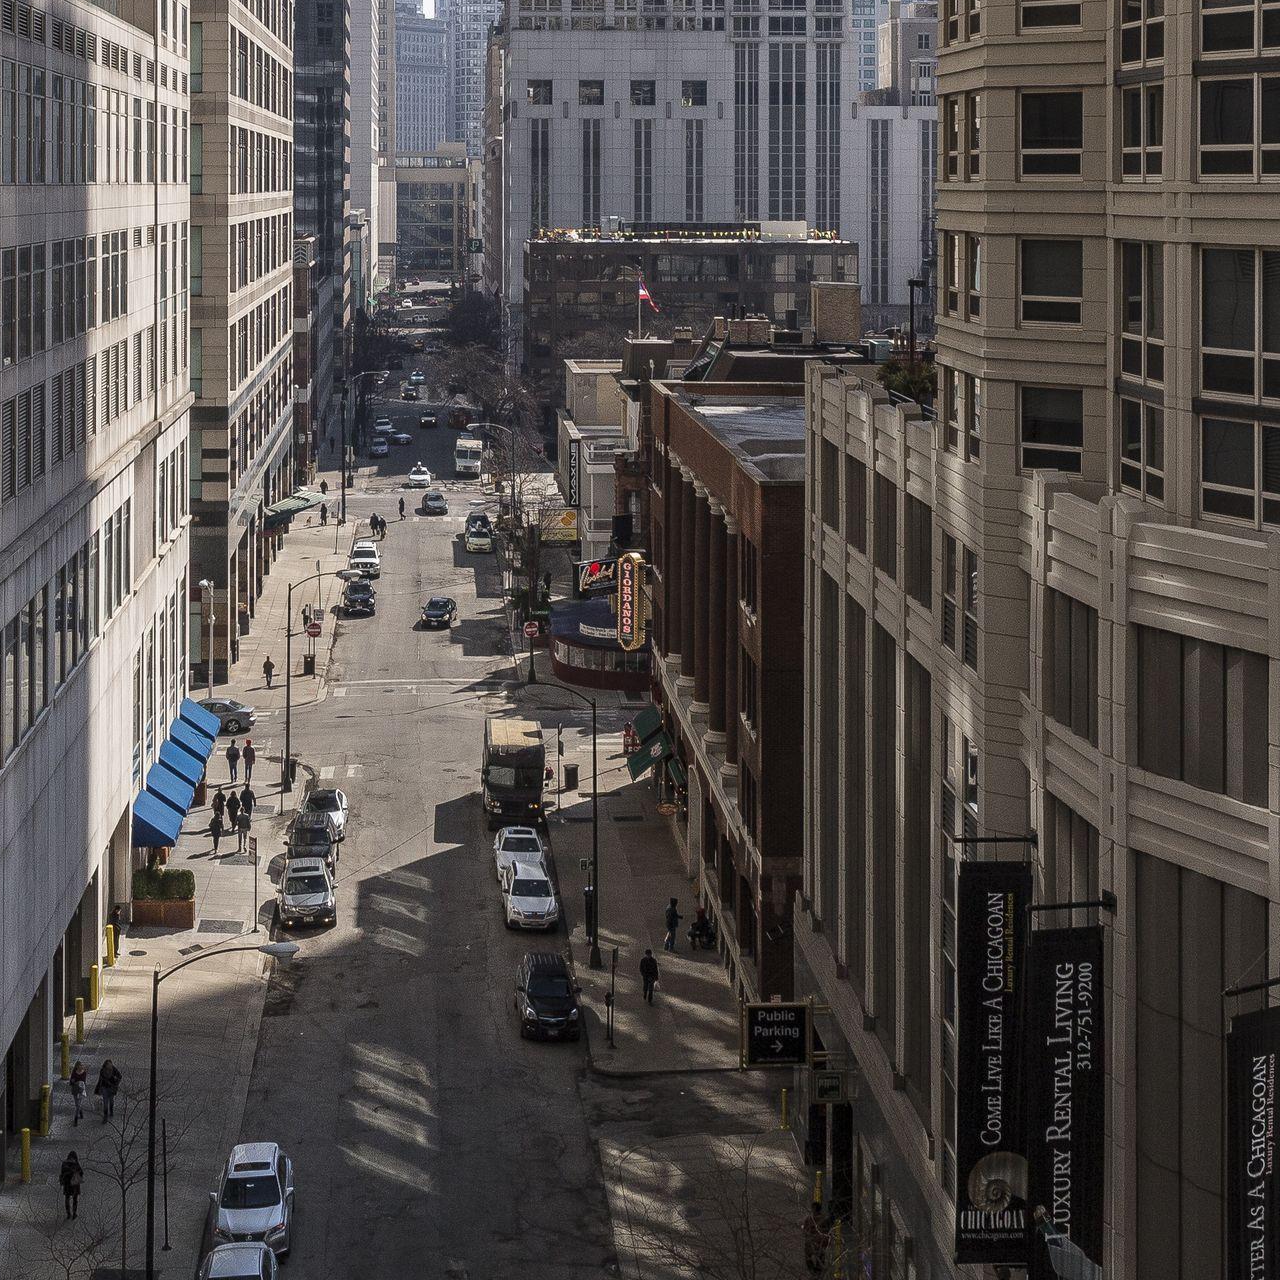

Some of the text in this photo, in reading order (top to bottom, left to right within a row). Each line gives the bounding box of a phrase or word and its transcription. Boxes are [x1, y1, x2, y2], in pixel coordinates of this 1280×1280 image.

[1004, 892, 1016, 993] Luxury Rental Residences
[754, 1026, 800, 1038] Parking
[757, 1010, 796, 1022] Public
[980, 892, 1004, 1146] COME LIVE LIKE A CHICAGOAN
[1077, 962, 1093, 1070] 312-751-9200
[1045, 962, 1074, 1242] LUXURY RENTAL LIVING
[1246, 1055, 1267, 1178] CHICAGOAN
[1265, 1053, 1276, 1175] Luxury Rental Residences
[1246, 1205, 1265, 1231] AS
[1247, 1180, 1265, 1199] A
